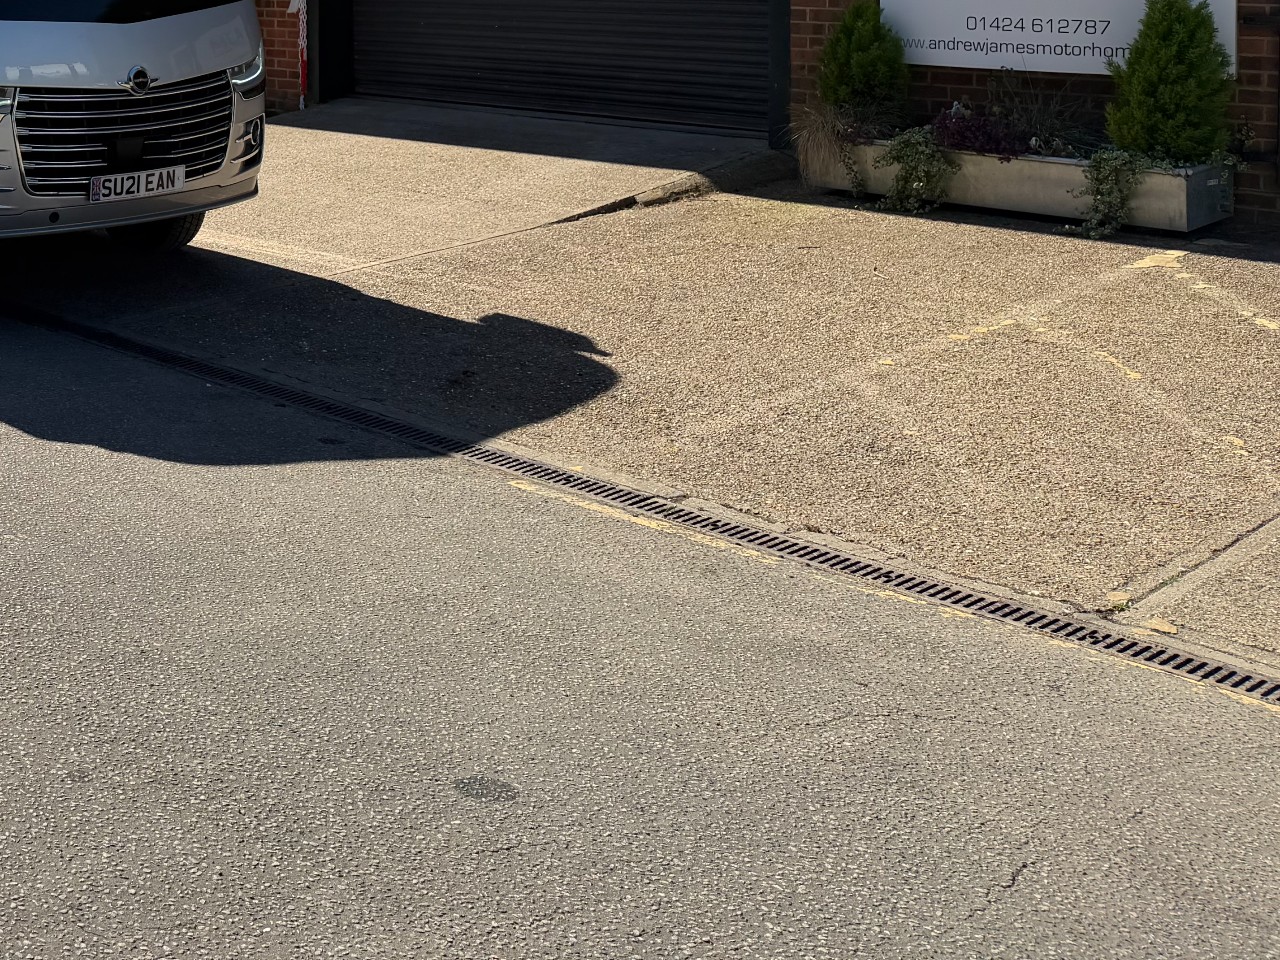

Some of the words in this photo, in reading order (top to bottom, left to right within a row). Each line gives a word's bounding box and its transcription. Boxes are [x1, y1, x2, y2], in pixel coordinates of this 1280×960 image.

[966, 16, 1026, 32] 01424
[1031, 18, 1112, 35] 612787
[901, 37, 1132, 58] ww.andrewjamesmotorhom
[101, 175, 141, 198] SU21
[145, 169, 176, 192] EAN
